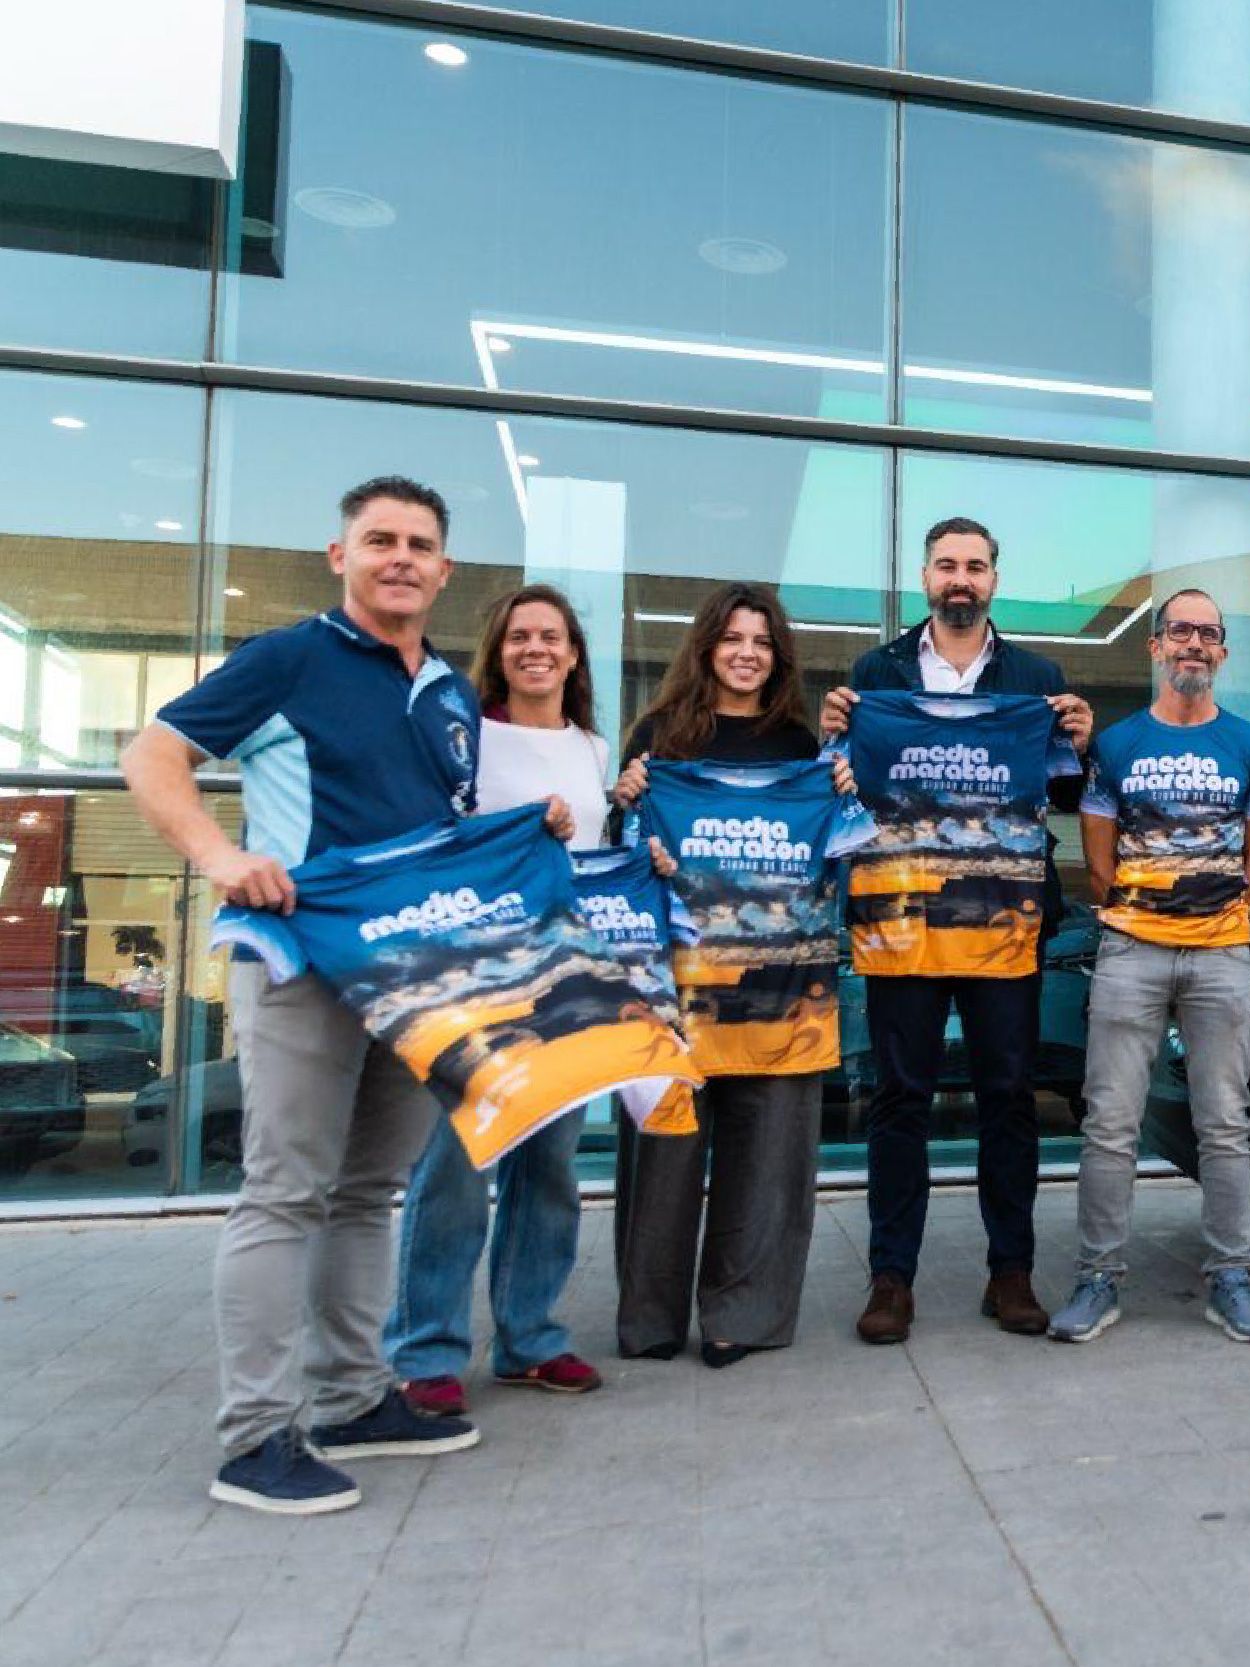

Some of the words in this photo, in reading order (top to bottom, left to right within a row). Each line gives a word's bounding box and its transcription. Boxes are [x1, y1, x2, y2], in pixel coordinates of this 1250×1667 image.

[902, 743, 988, 763] media
[889, 763, 1010, 782] maraton
[1132, 753, 1218, 774] media
[1122, 773, 1240, 793] maraton
[692, 816, 789, 839] media
[680, 837, 812, 861] maraton
